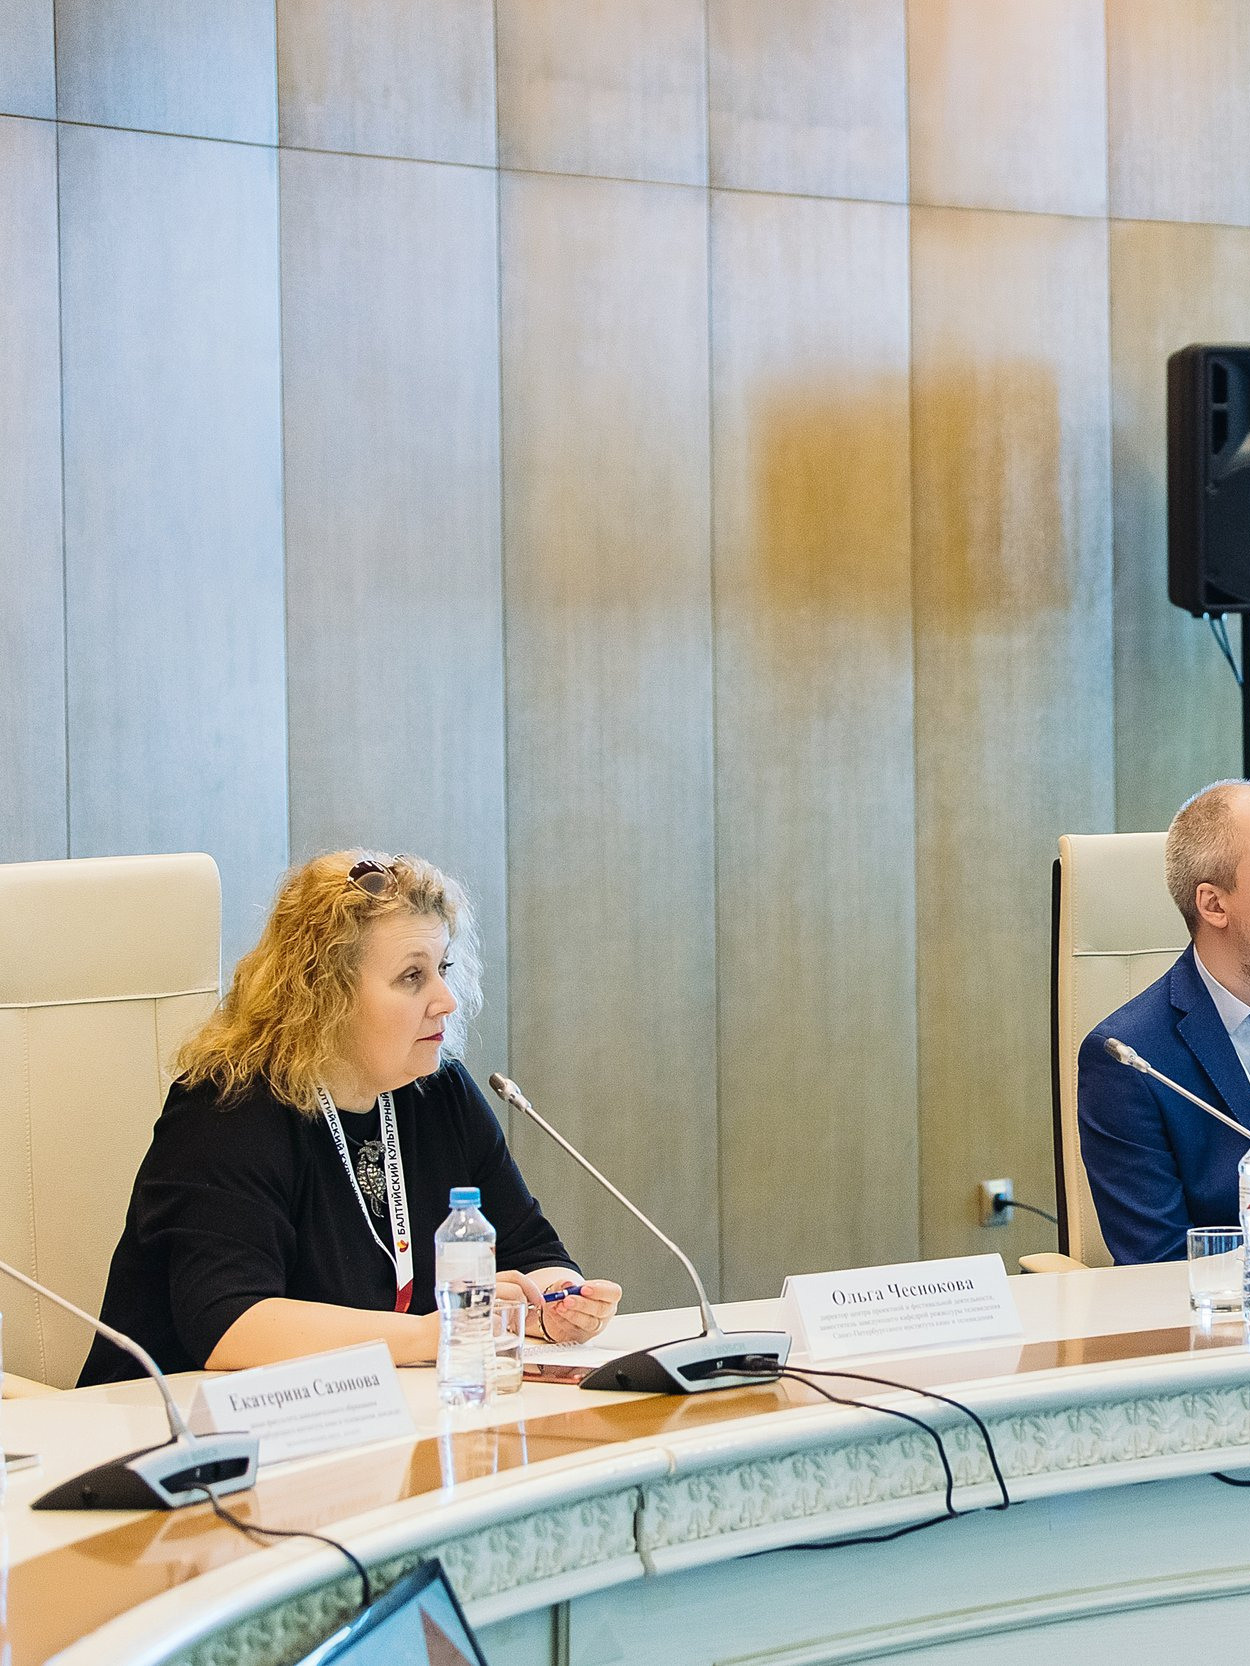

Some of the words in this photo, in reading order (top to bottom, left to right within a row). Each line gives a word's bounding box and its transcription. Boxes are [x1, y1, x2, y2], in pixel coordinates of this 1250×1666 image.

[316, 1085, 345, 1152] АЛТИЙСКИЙ
[380, 1092, 398, 1160] КУЛЬТУРНЫЙ
[388, 1163, 406, 1235] БАЛТИЙСКИЙ
[831, 1289, 884, 1307] Ольга
[887, 1277, 975, 1299] Чеснокова
[228, 1386, 311, 1412] Екатерина
[312, 1373, 380, 1397] Сазонова
